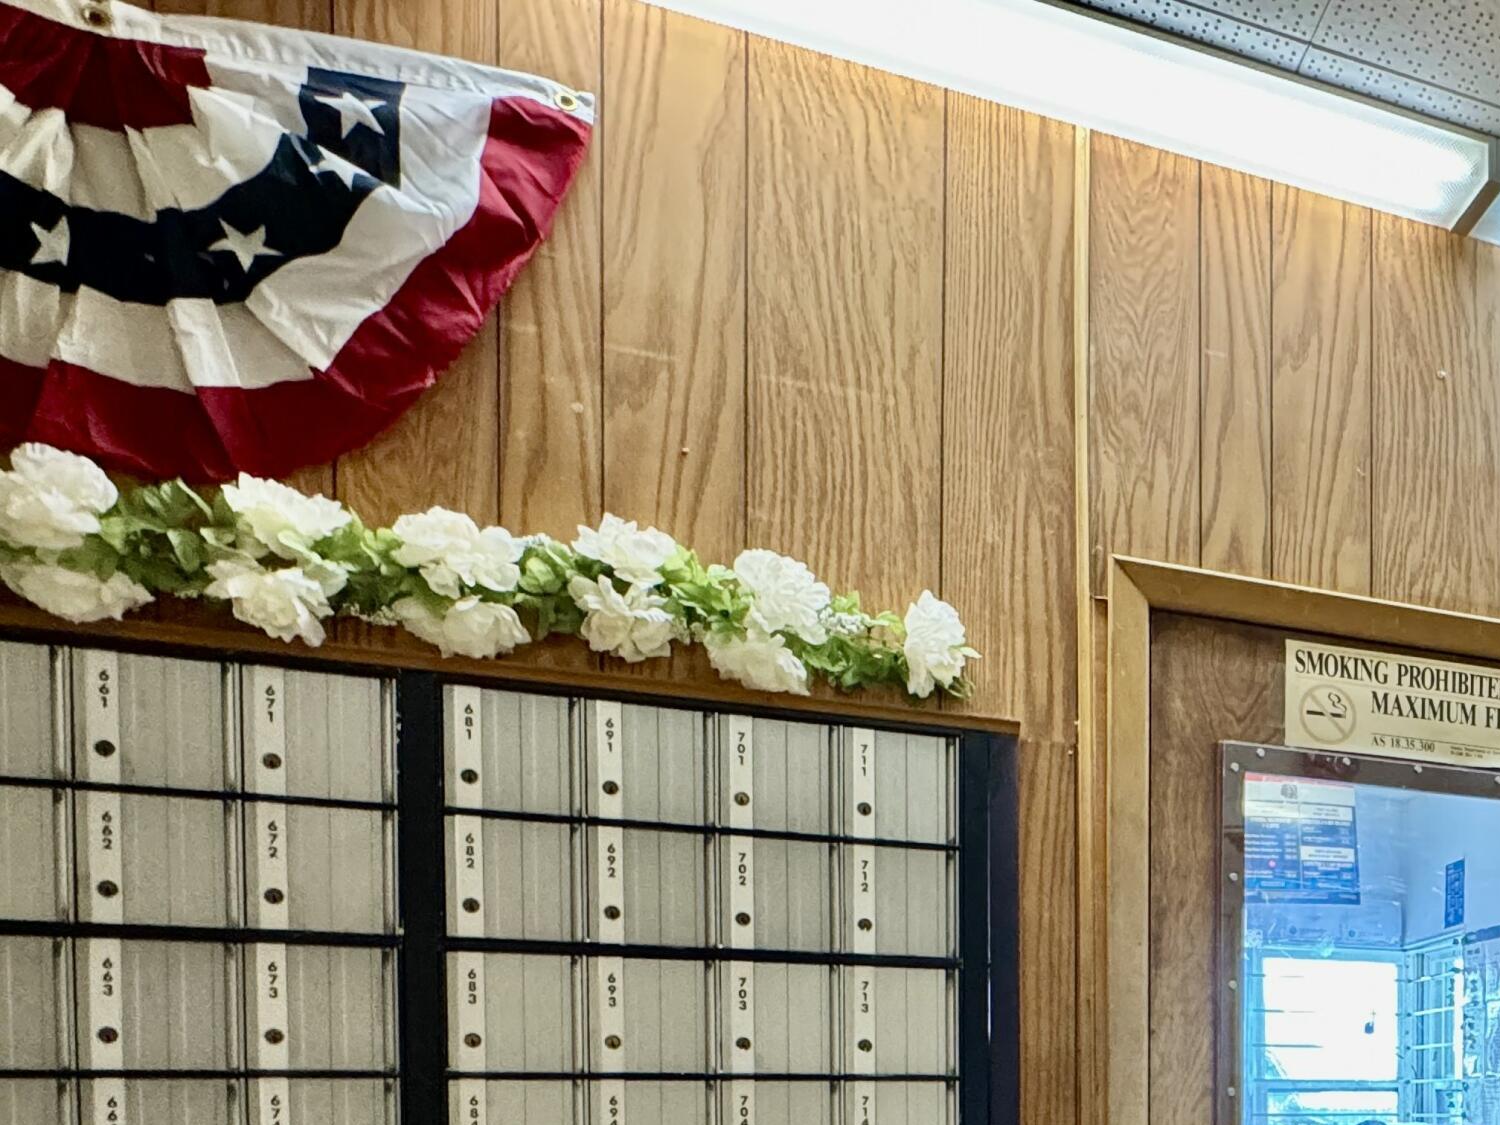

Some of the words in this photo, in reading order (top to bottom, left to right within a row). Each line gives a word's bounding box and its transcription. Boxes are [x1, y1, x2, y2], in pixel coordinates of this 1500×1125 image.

[1295, 650, 1389, 684] SMOKING
[98, 669, 110, 709] 661
[265, 685, 276, 723] 671
[464, 703, 474, 740] 681
[1371, 691, 1478, 727] MAXIMUM
[605, 717, 615, 753] 691
[736, 731, 746, 766] 701
[1371, 736, 1385, 747] AS
[1391, 738, 1435, 753] 18.35.300
[860, 743, 869, 777] 711
[101, 811, 113, 850] 662
[267, 820, 278, 859] 672
[465, 832, 475, 869] 682
[607, 843, 616, 878] 692
[738, 852, 747, 886] 702
[860, 859, 869, 893] 712
[101, 957, 113, 997] 663
[267, 961, 278, 999] 673
[467, 968, 477, 1005] 683
[607, 973, 617, 1008] 693
[738, 977, 747, 1011] 703
[861, 980, 870, 1014] 713
